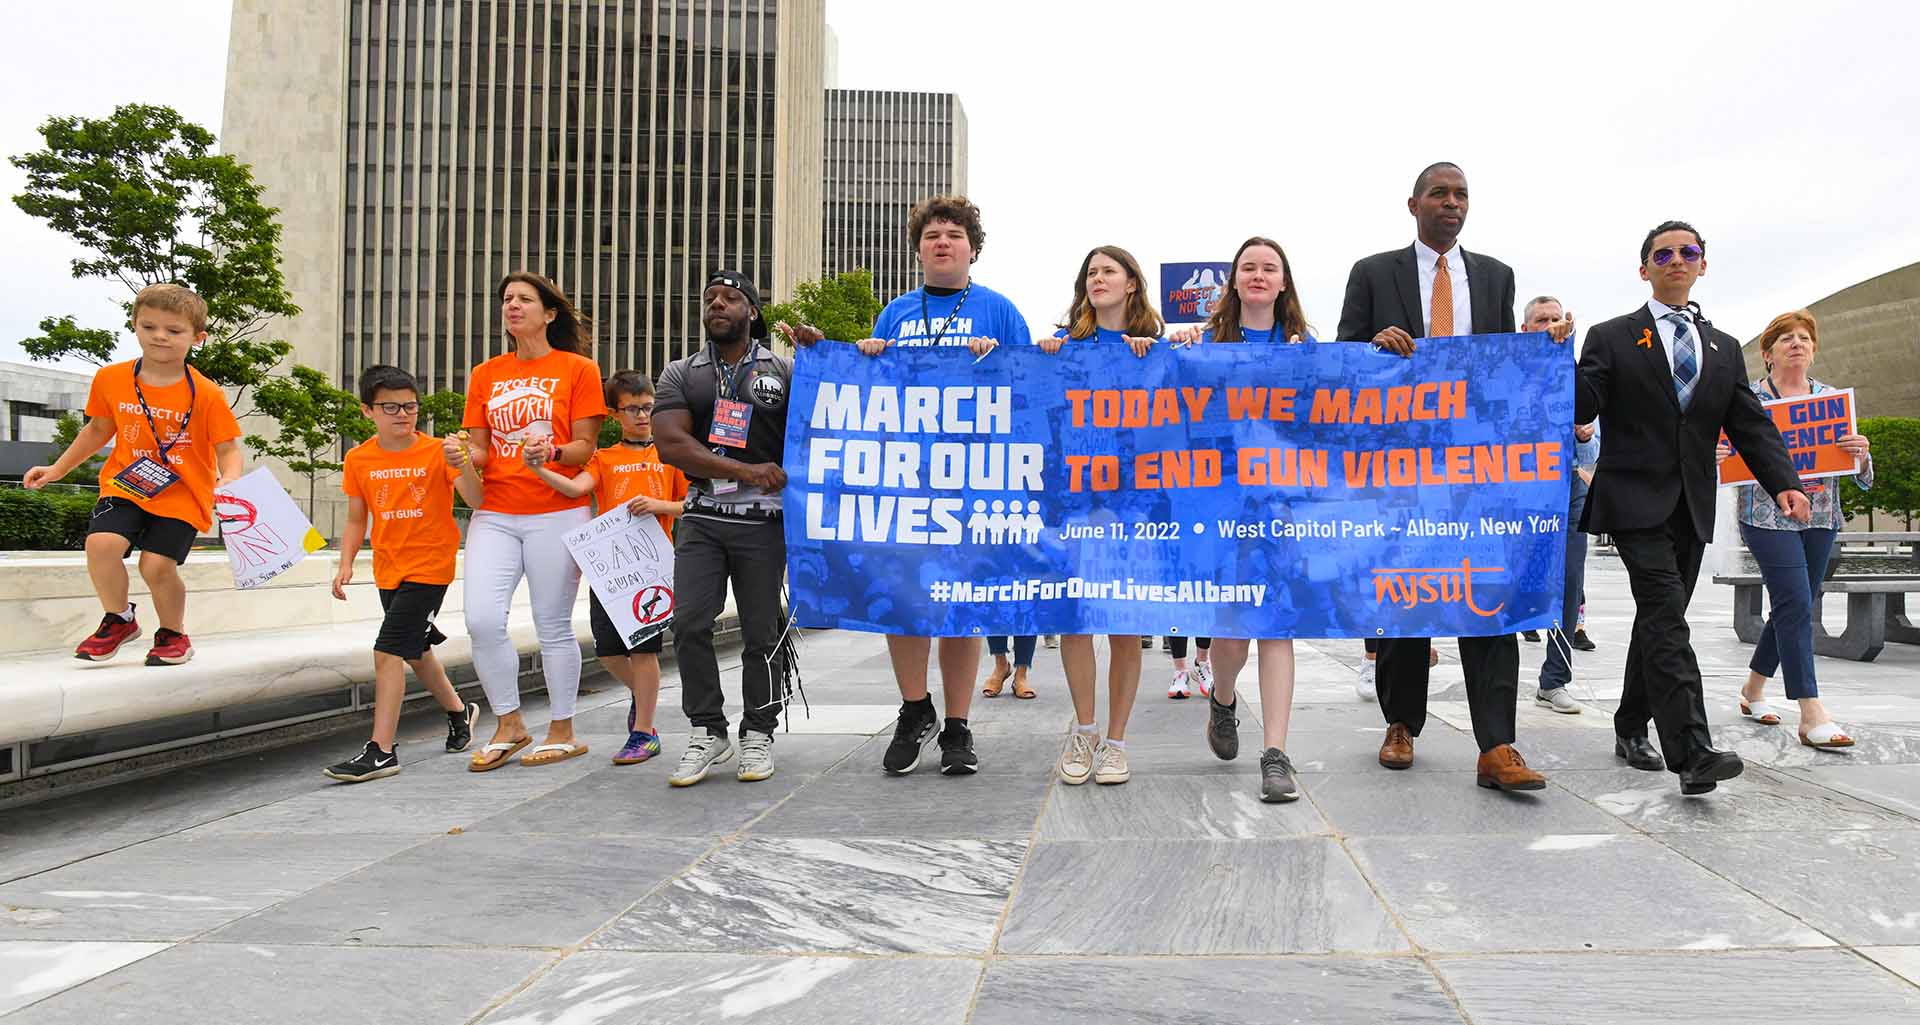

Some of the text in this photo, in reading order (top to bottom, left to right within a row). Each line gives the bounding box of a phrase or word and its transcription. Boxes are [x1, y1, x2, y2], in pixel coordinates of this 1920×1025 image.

[1169, 286, 1216, 303] PROTECT
[1179, 301, 1199, 315] NOT
[899, 317, 972, 338] MARCH
[491, 376, 560, 399] PROTECT
[488, 396, 553, 432] CHILDREN
[810, 381, 1011, 434] MARCH
[1066, 380, 1467, 428] TODAY WE MARCH
[1789, 397, 1846, 425] GUN
[1782, 422, 1848, 449] ENCE
[370, 467, 427, 481] PROTECT US
[613, 462, 664, 473] PROTECT US
[808, 438, 1044, 491] FOR OUR
[1065, 442, 1561, 492] TO END GUN VIOLENCE
[396, 508, 424, 519] GUNS
[806, 492, 964, 545] LIVES
[1059, 523, 1105, 540] June
[1109, 522, 1129, 542] 11,
[1134, 522, 1181, 540] 2022
[1217, 520, 1266, 538] West
[1271, 519, 1337, 542] Capitol
[1341, 519, 1386, 538] Park
[1406, 518, 1475, 541] Albany,
[1480, 517, 1523, 536] New
[1528, 514, 1560, 534] York
[583, 527, 660, 575] BAN
[930, 577, 1267, 607] #MarchForOurLivesAlbany
[1371, 556, 1505, 617] nysut
